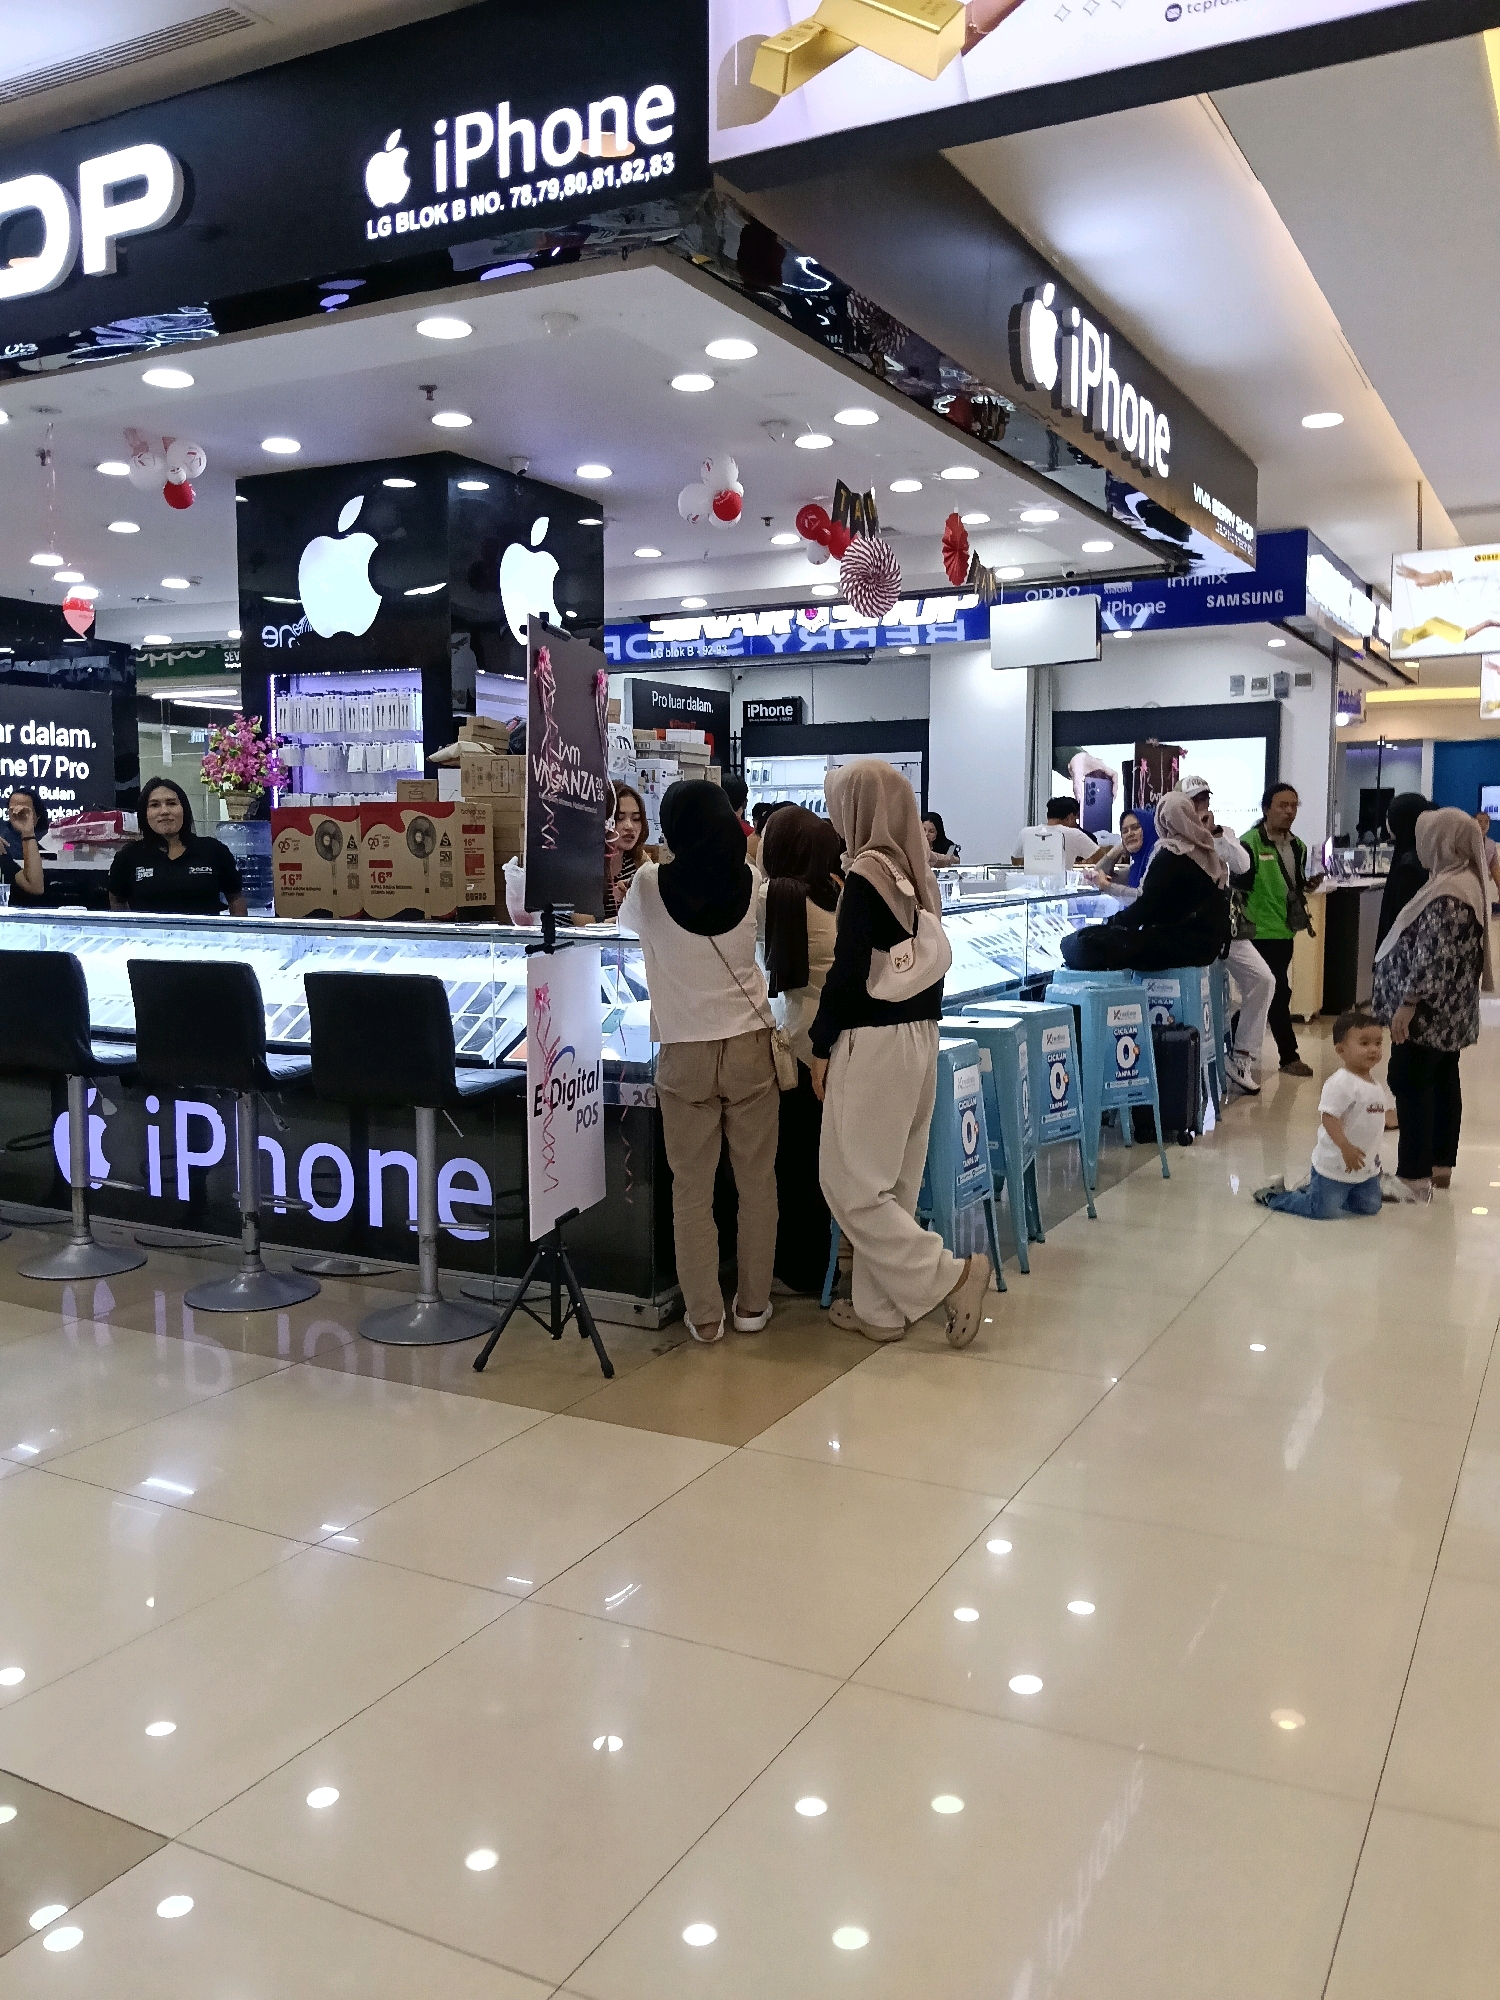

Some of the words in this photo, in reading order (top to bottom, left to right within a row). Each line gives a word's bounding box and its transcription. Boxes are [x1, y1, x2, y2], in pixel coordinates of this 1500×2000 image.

[434, 84, 675, 193] iPhone
[367, 215, 392, 240] LG
[396, 202, 448, 234] BLOK
[452, 199, 467, 221] B
[471, 192, 504, 217] NO.
[510, 152, 675, 207] 78,79,80,81,82,83
[1064, 307, 1171, 478] iPhone
[1107, 599, 1166, 617] iPhone
[1206, 589, 1284, 608] SAMSUNG
[651, 648, 664, 659] LG
[666, 646, 685, 658] blok
[688, 645, 694, 657] B
[652, 691, 667, 708] Pro
[669, 693, 685, 710] luar
[686, 696, 714, 713] dalam.
[747, 703, 794, 718] iPhone
[20, 719, 97, 748] dalam.
[29, 754, 52, 777] 17
[55, 755, 90, 780] Pro
[38, 785, 76, 800] Bulan
[146, 1095, 493, 1241] iPhone
